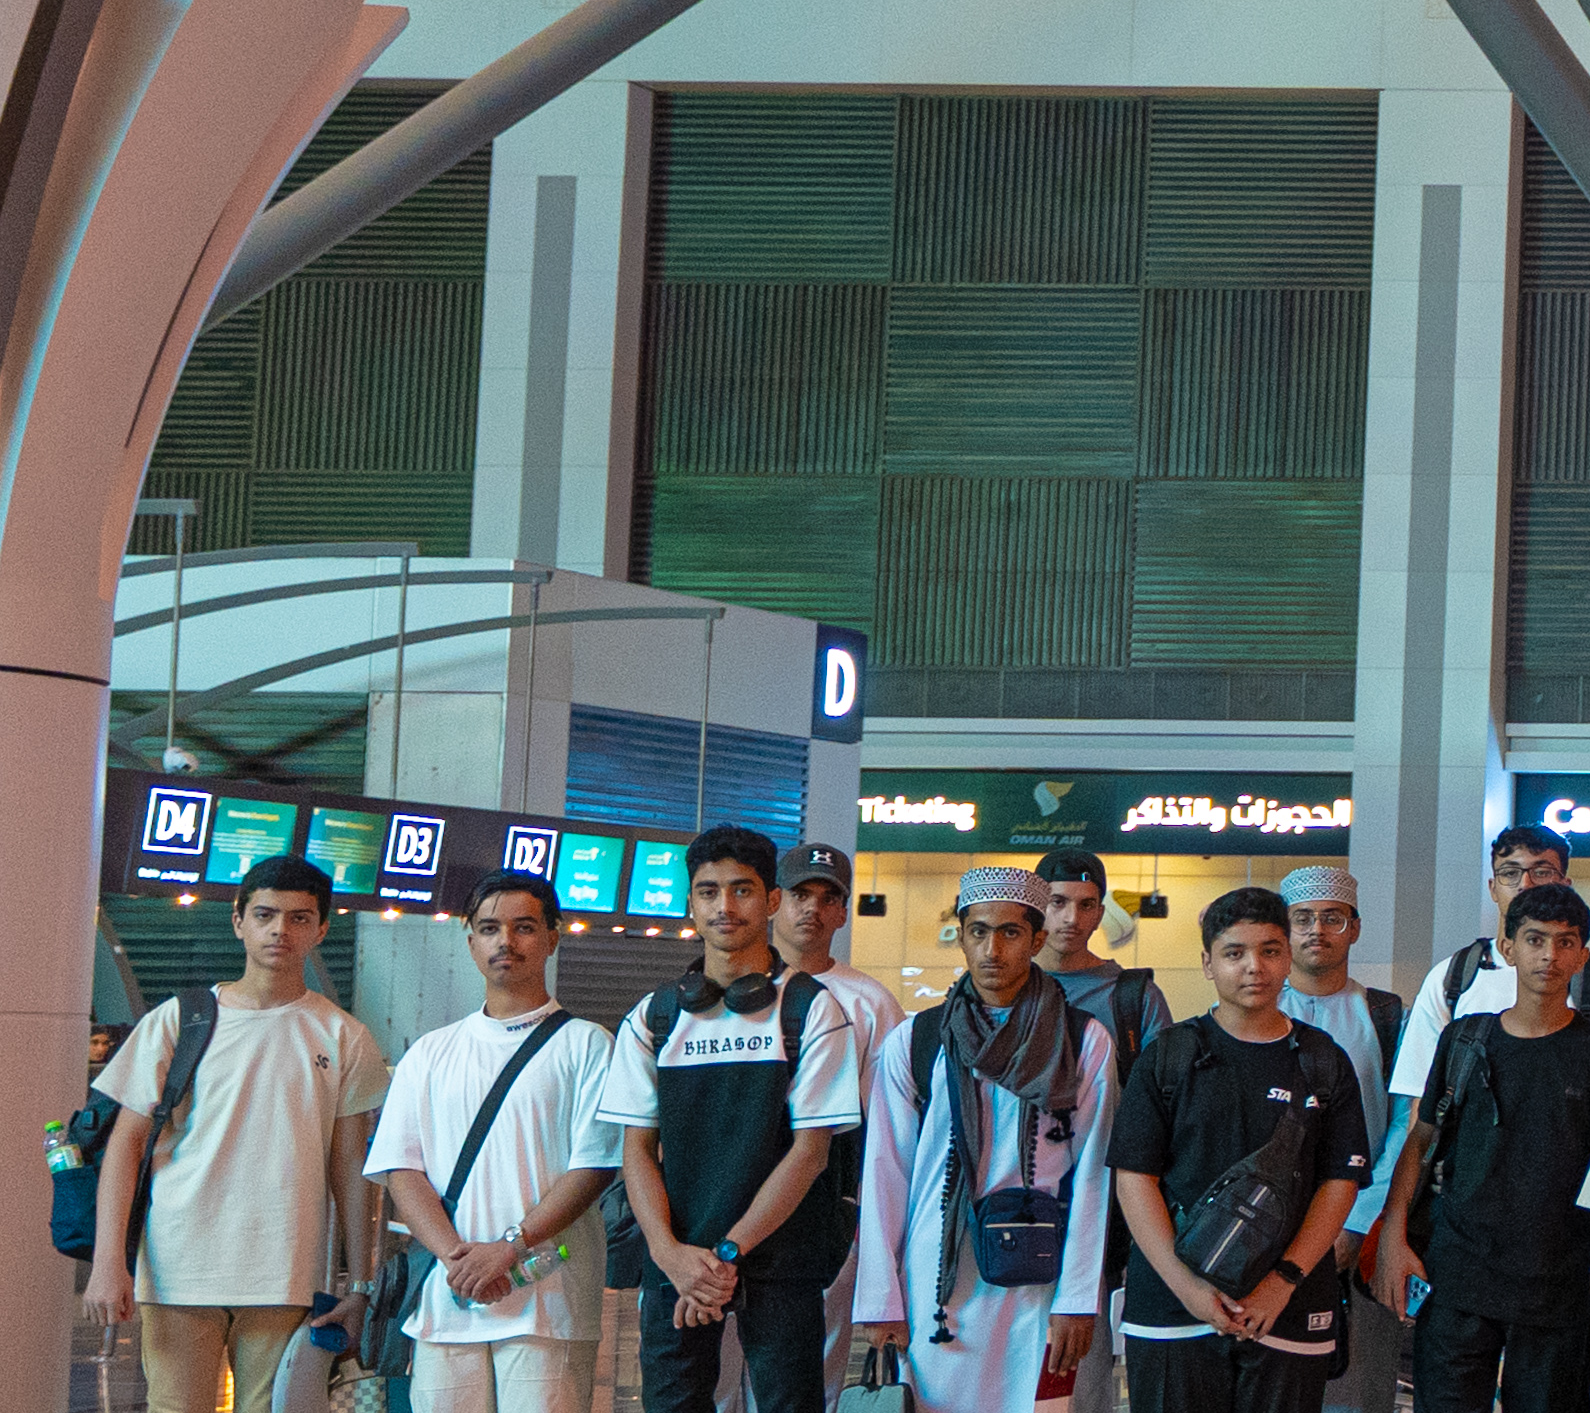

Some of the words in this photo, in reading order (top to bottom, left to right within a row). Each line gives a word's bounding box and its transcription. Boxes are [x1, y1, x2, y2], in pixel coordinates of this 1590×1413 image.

[823, 646, 857, 718] D
[154, 798, 198, 843] D4
[857, 795, 976, 832] Ticketing
[1120, 794, 1226, 834] والتذاكر
[1230, 794, 1352, 834] الحجوزات
[395, 825, 433, 865] D3
[513, 836, 547, 875] D2
[1009, 834, 1057, 844] OMAN
[1058, 835, 1085, 844] AIR
